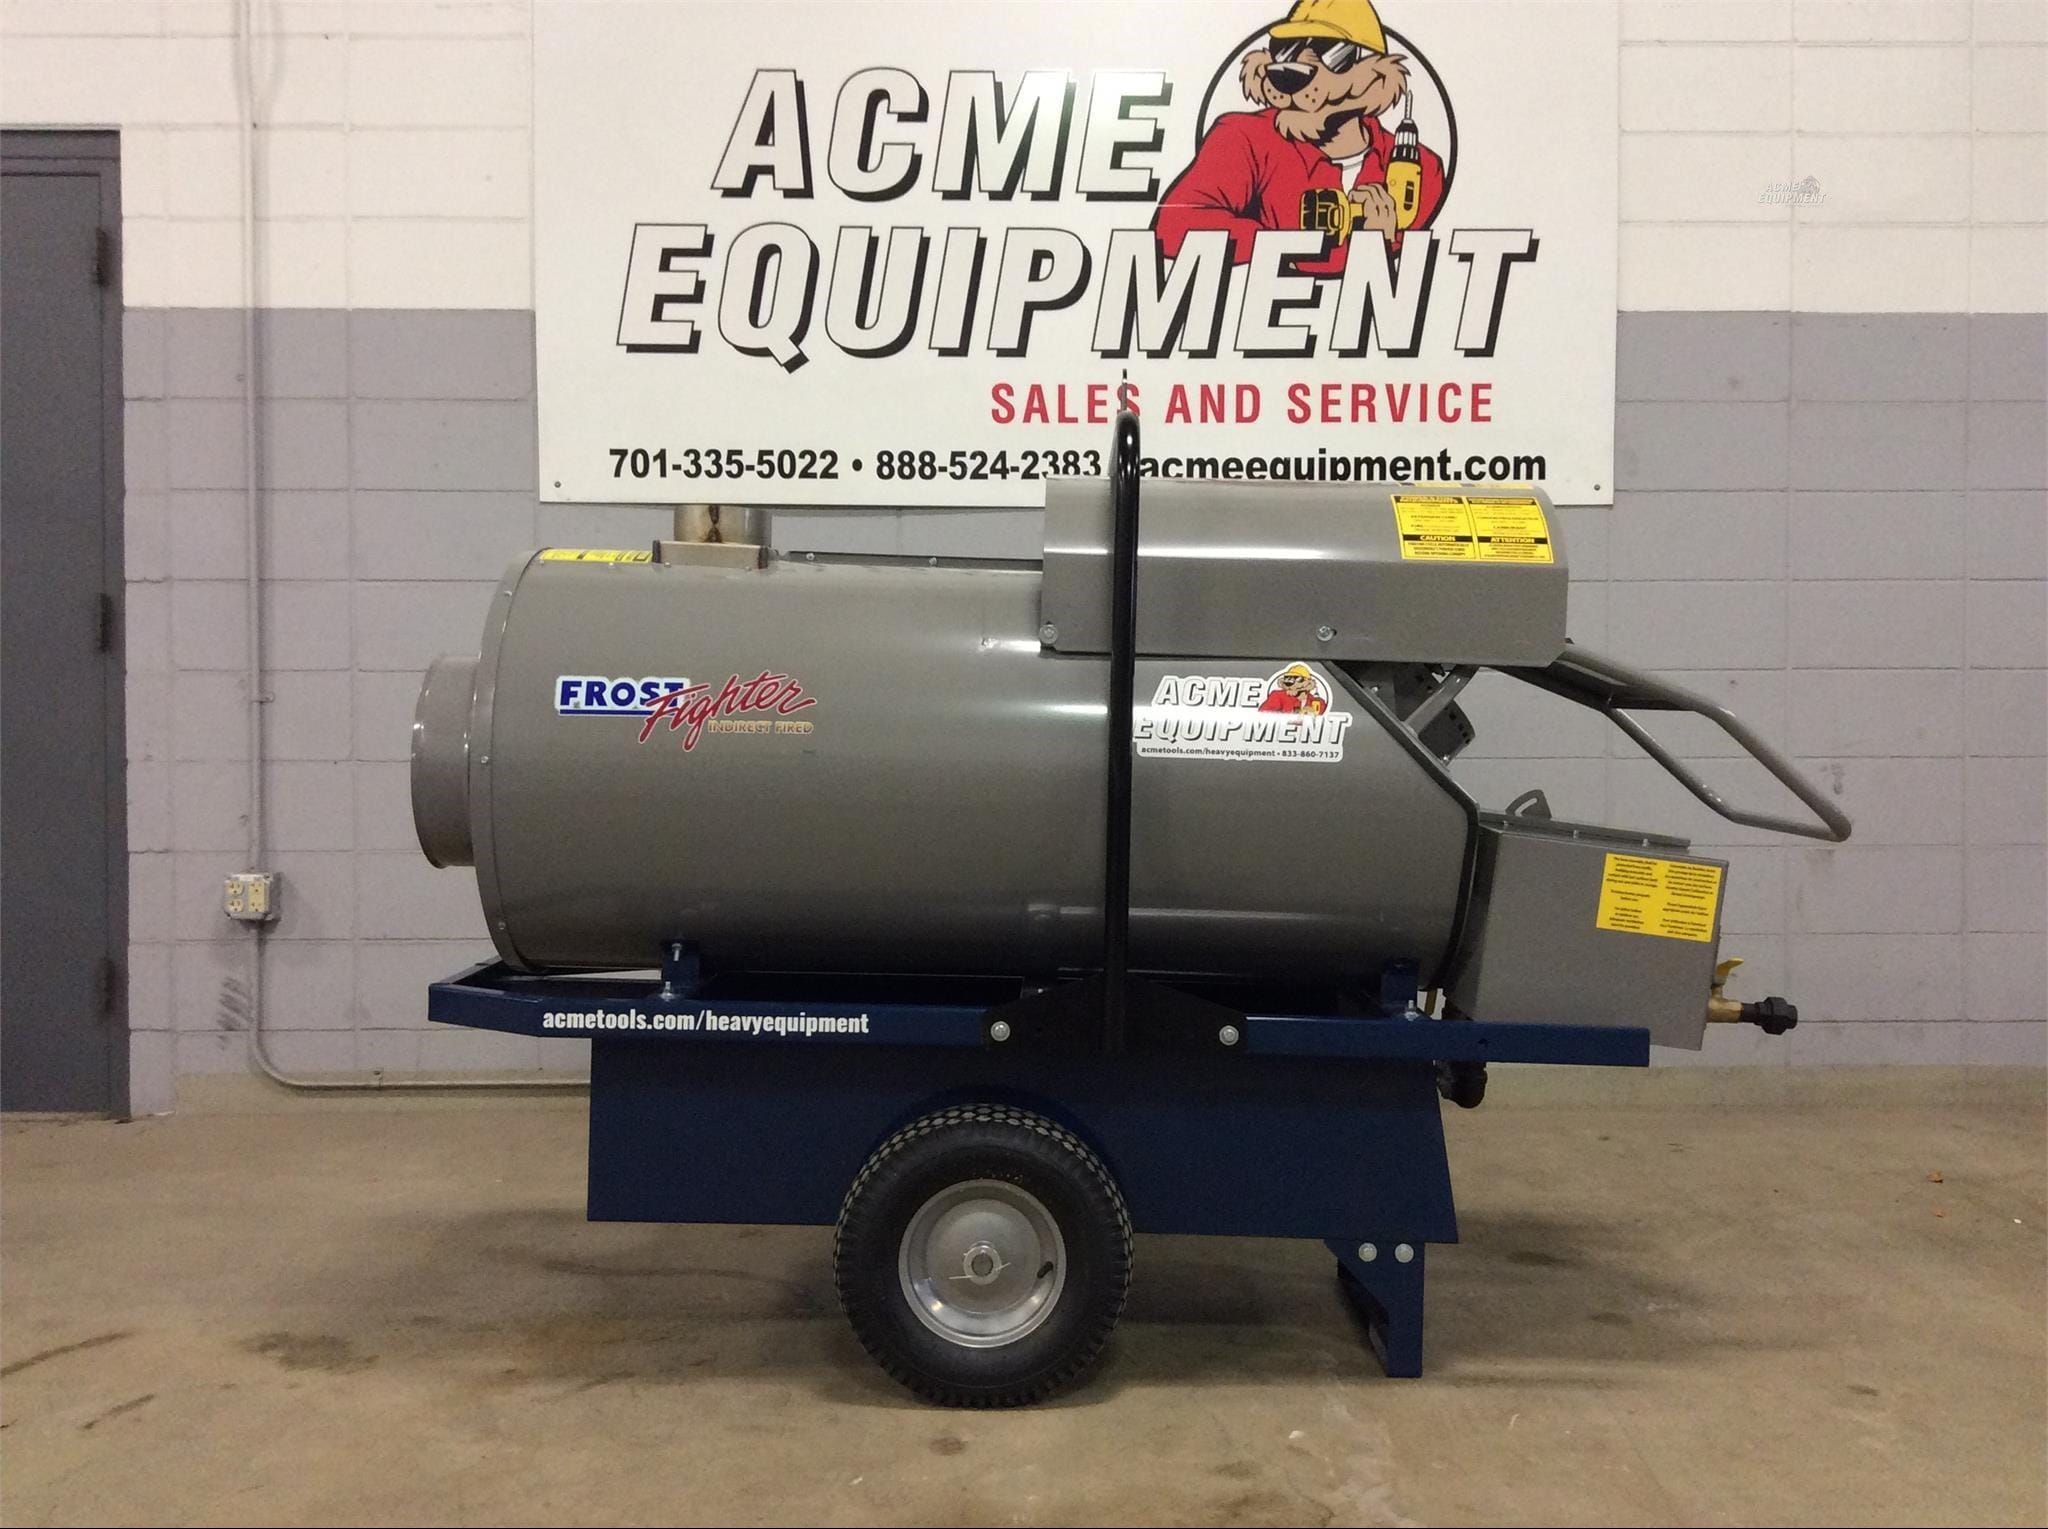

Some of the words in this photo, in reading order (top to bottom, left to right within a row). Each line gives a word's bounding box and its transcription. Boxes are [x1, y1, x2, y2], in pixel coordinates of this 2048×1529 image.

[711, 67, 1173, 202] ACME
[616, 222, 1540, 374] EQUIPMENT
[991, 382, 1140, 425] SALES
[1165, 383, 1261, 424] AND
[1287, 382, 1492, 424] SERVICE
[609, 448, 839, 480] 701-335-5022
[876, 449, 1101, 481] 888-524-2383
[1139, 448, 1547, 481] acmeequipment.com
[1420, 534, 1456, 543] CAUTION
[1490, 536, 1536, 545] ATTENTION
[1157, 677, 1263, 708] ACME
[559, 680, 684, 708] FROST
[638, 670, 817, 751] Fighter
[708, 720, 771, 734] INDIRECT
[774, 720, 815, 735] FIRED
[1133, 714, 1350, 745] EQUIPMENT
[1141, 747, 1276, 759] acmetools.com/heavyequipment
[1281, 749, 1340, 760] 833-860-7137
[542, 1009, 870, 1037] acmetools.com/heavyequipment
